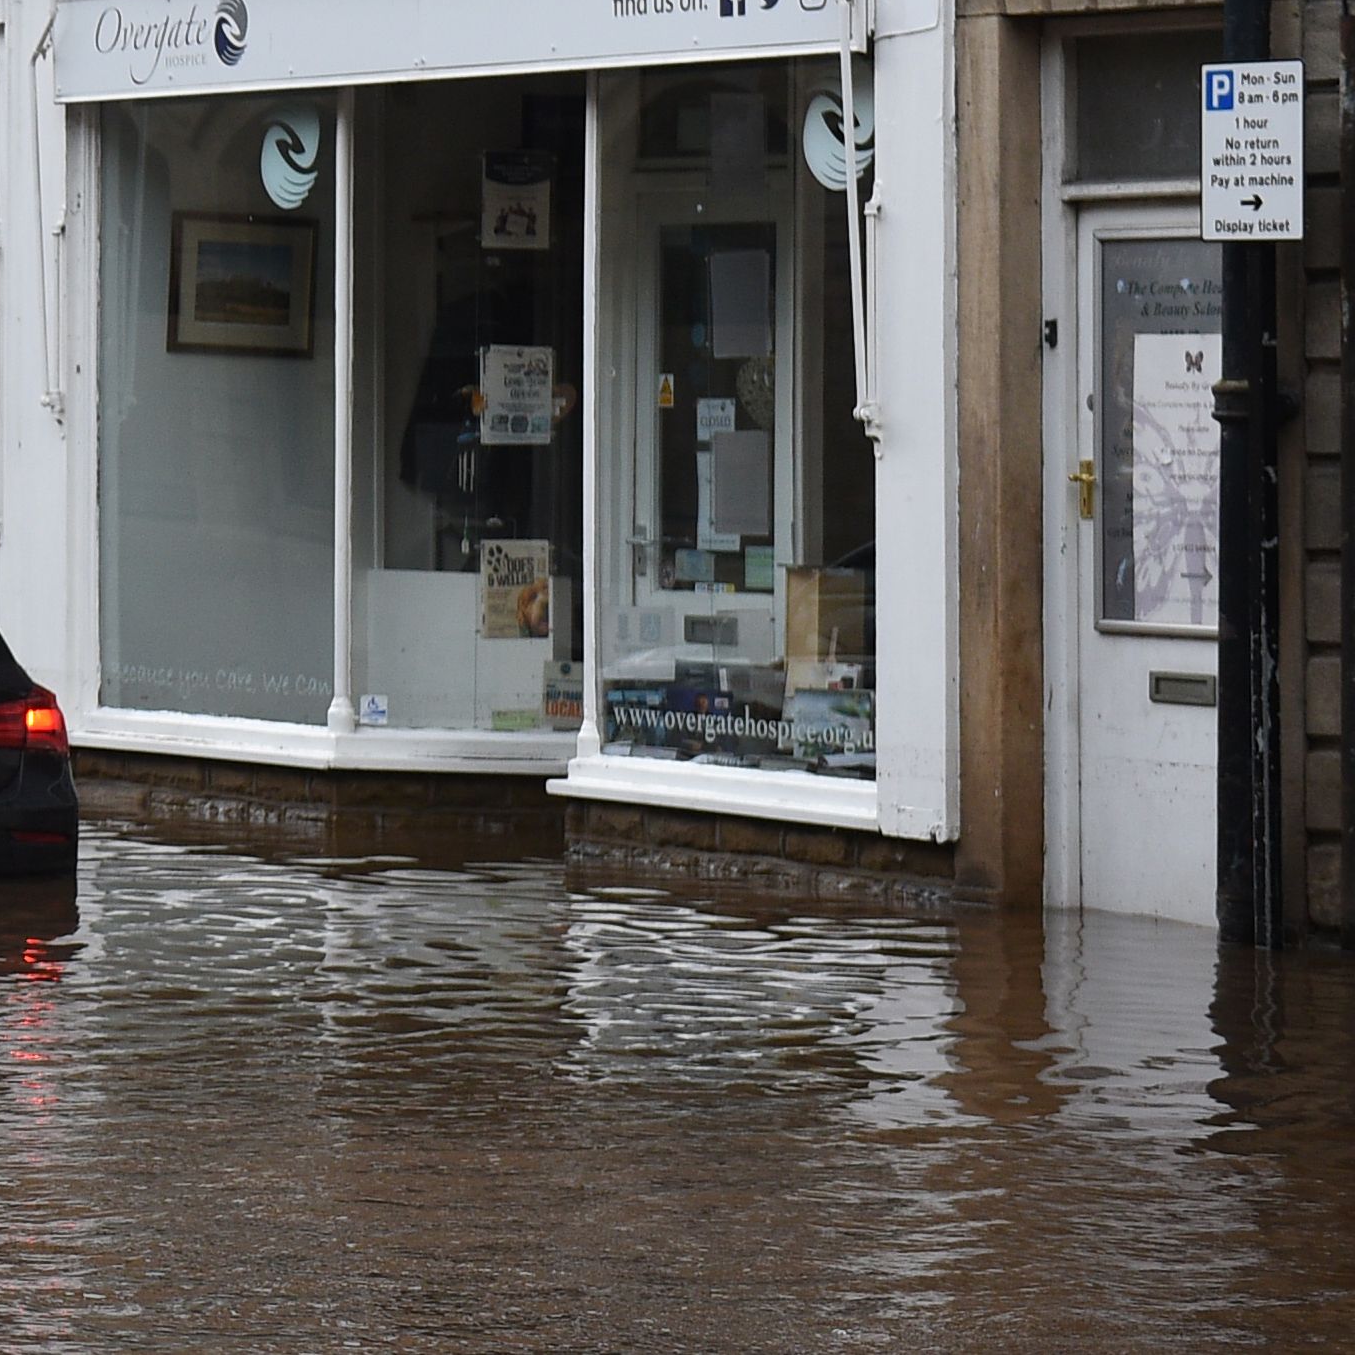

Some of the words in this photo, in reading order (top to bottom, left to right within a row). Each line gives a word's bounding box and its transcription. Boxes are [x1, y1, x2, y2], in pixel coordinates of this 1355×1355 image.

[95, 4, 208, 84] Overgate
[165, 54, 207, 67] HOSPICE
[1241, 73, 1264, 86] Mon
[1274, 72, 1295, 84] Sun
[1212, 74, 1230, 108] P
[1235, 117, 1240, 130] 1
[1243, 118, 1268, 130] hour
[1226, 137, 1240, 150] No
[1245, 138, 1279, 150] return
[1213, 154, 1246, 167] within
[1250, 153, 1256, 166] 2
[1260, 153, 1291, 166] hours
[1211, 175, 1230, 189] Pay
[1234, 176, 1245, 187] at
[1248, 174, 1294, 187] machine
[1214, 219, 1254, 234] Display
[1258, 219, 1290, 232] ticket
[1153, 301, 1189, 320] Beauty
[613, 705, 875, 753] www.overgatehospice.org.u
